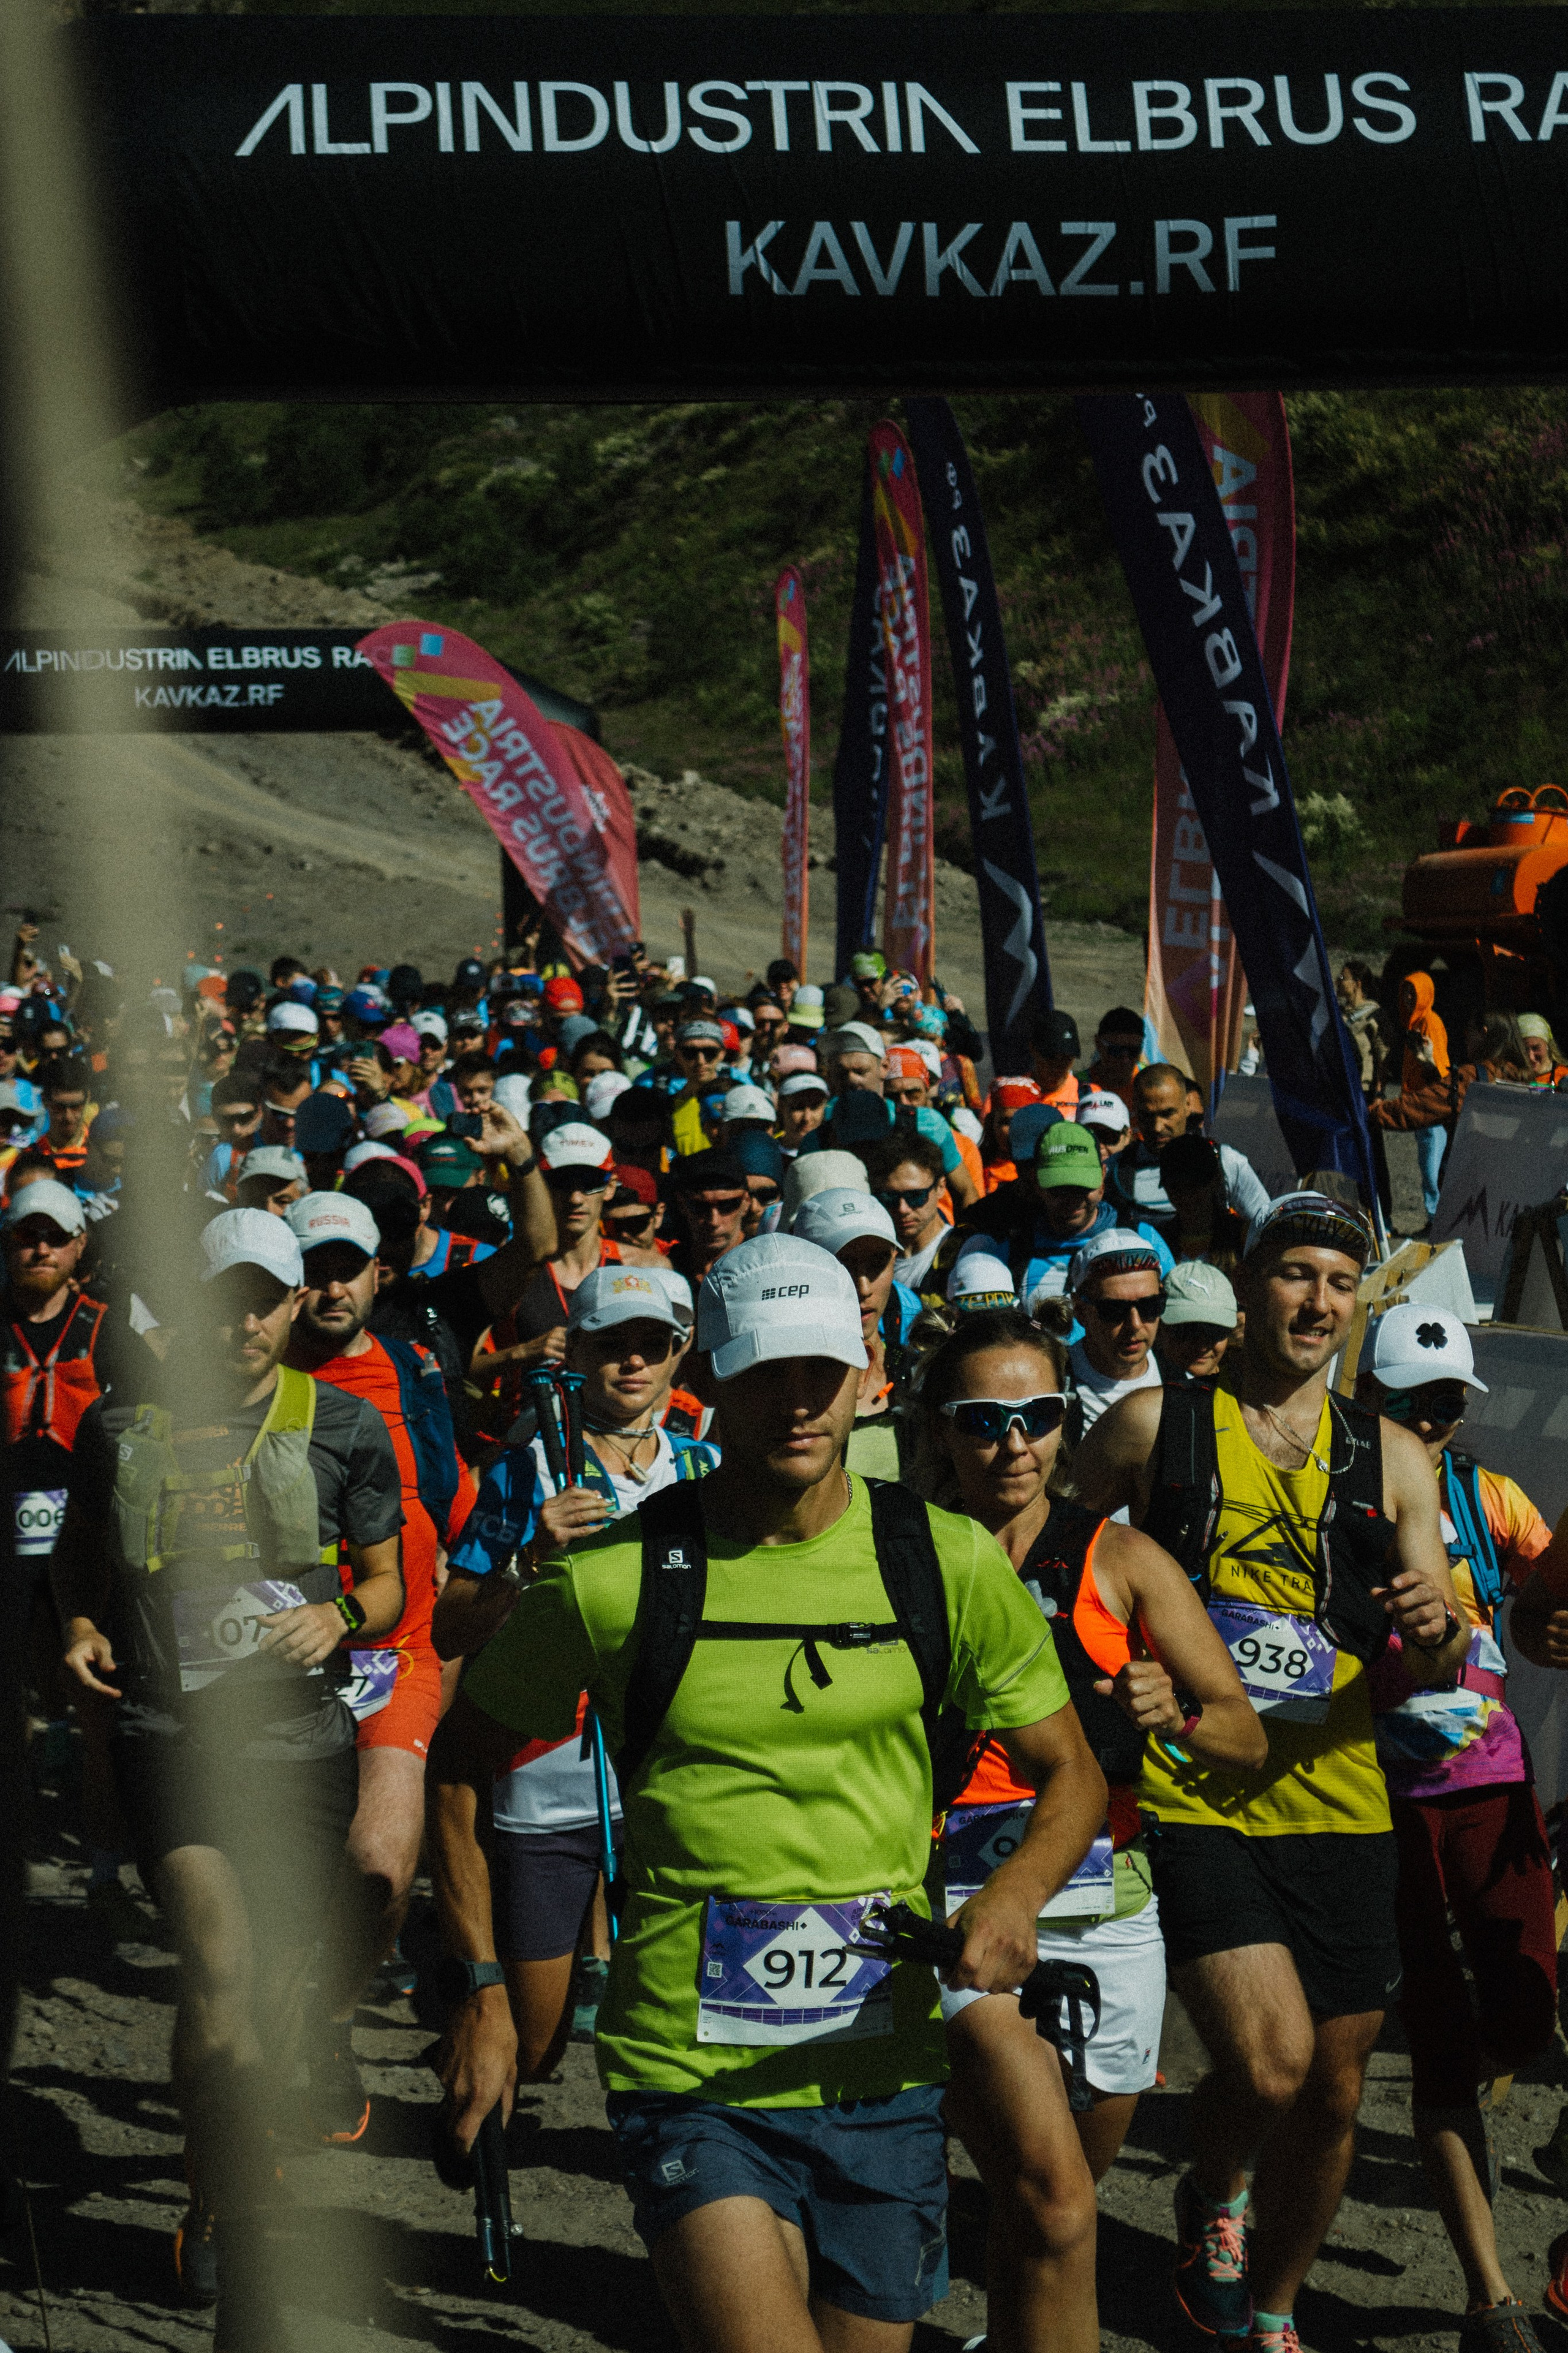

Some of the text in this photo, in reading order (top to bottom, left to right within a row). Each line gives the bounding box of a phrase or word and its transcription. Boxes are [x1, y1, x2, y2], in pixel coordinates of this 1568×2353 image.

[235, 80, 981, 156] ALPINDUSTRIA
[1005, 72, 1417, 152] ELBRUS
[725, 214, 1278, 296] KAVKAZ.RF
[4, 646, 203, 673] ALPINDUSTRIA
[206, 646, 322, 670] ELBRUS
[134, 684, 285, 708] KAVKAZ.RF
[778, 1284, 810, 1299] cep
[1231, 1565, 1272, 1584] NIKE
[1236, 1637, 1308, 1679] 938
[726, 1915, 799, 1931] GARABASHI
[763, 1949, 848, 1990] 912
